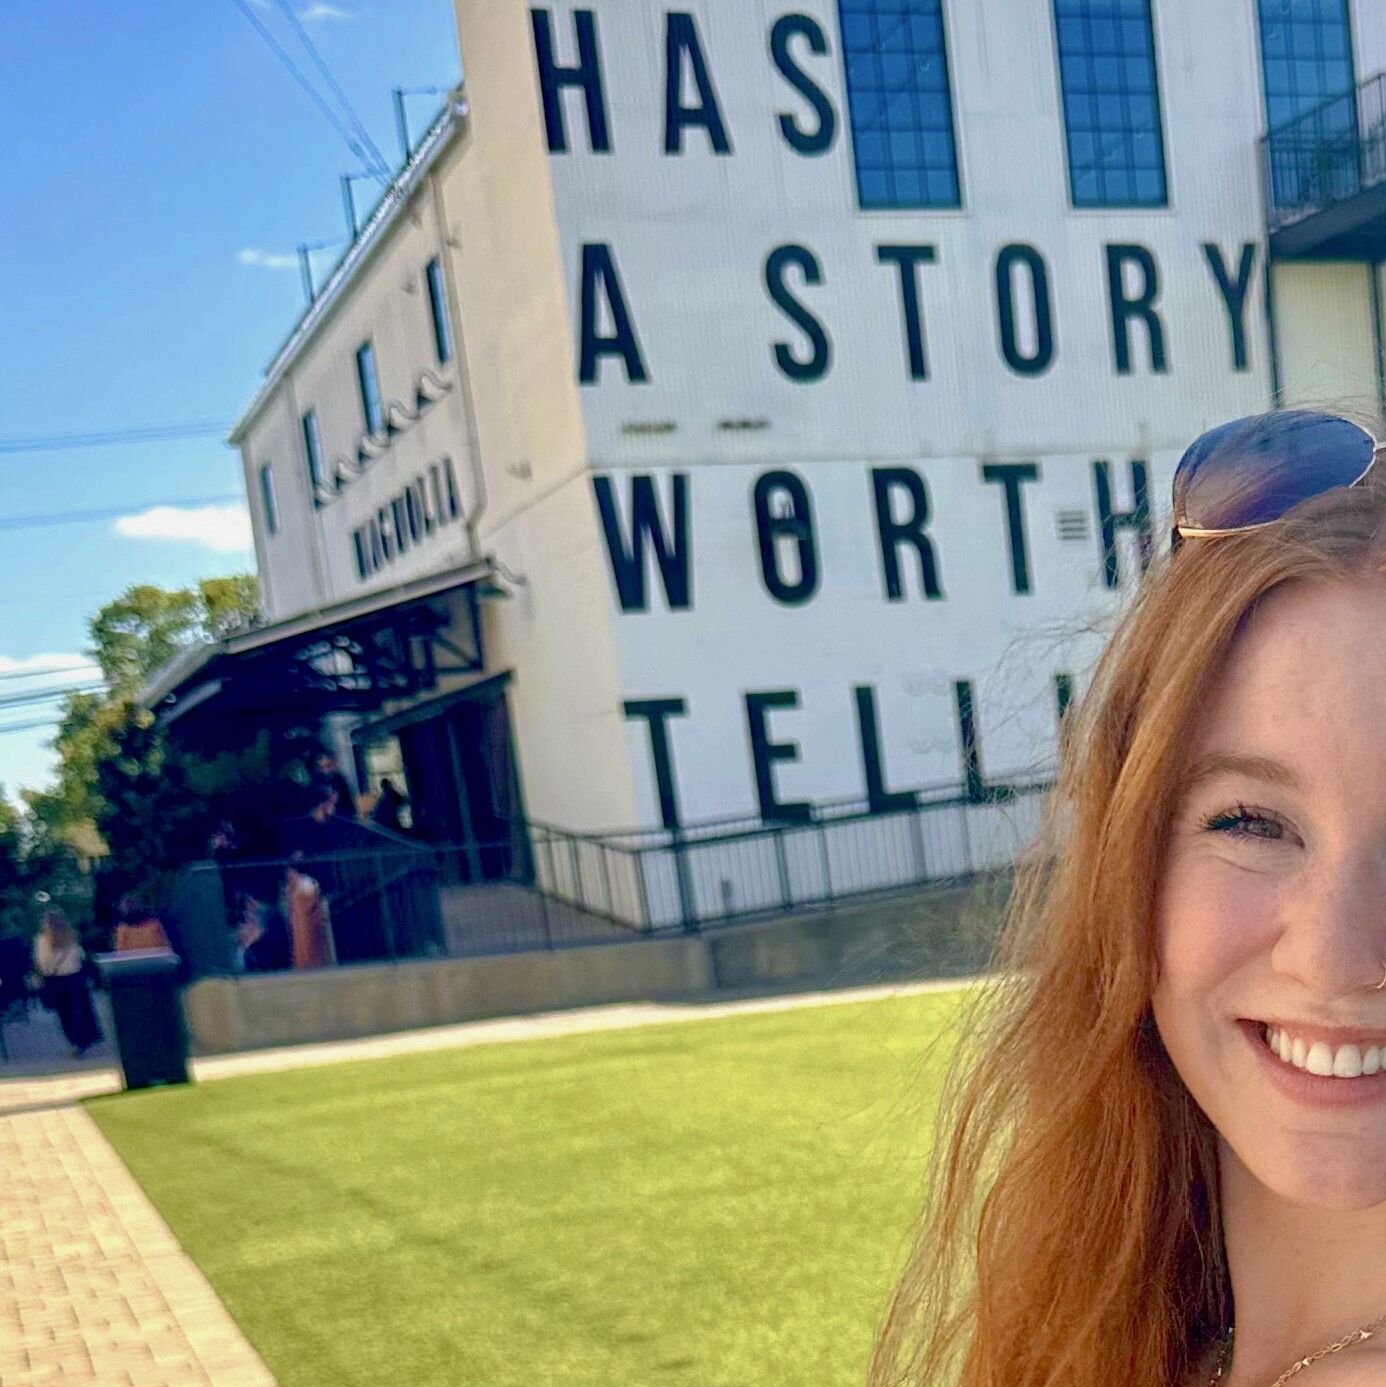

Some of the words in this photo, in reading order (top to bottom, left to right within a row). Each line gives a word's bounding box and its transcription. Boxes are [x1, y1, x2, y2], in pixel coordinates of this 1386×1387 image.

[530, 8, 836, 157] HAS
[578, 242, 648, 384] A
[764, 242, 1257, 383] STORY
[592, 460, 1151, 610] WORTH
